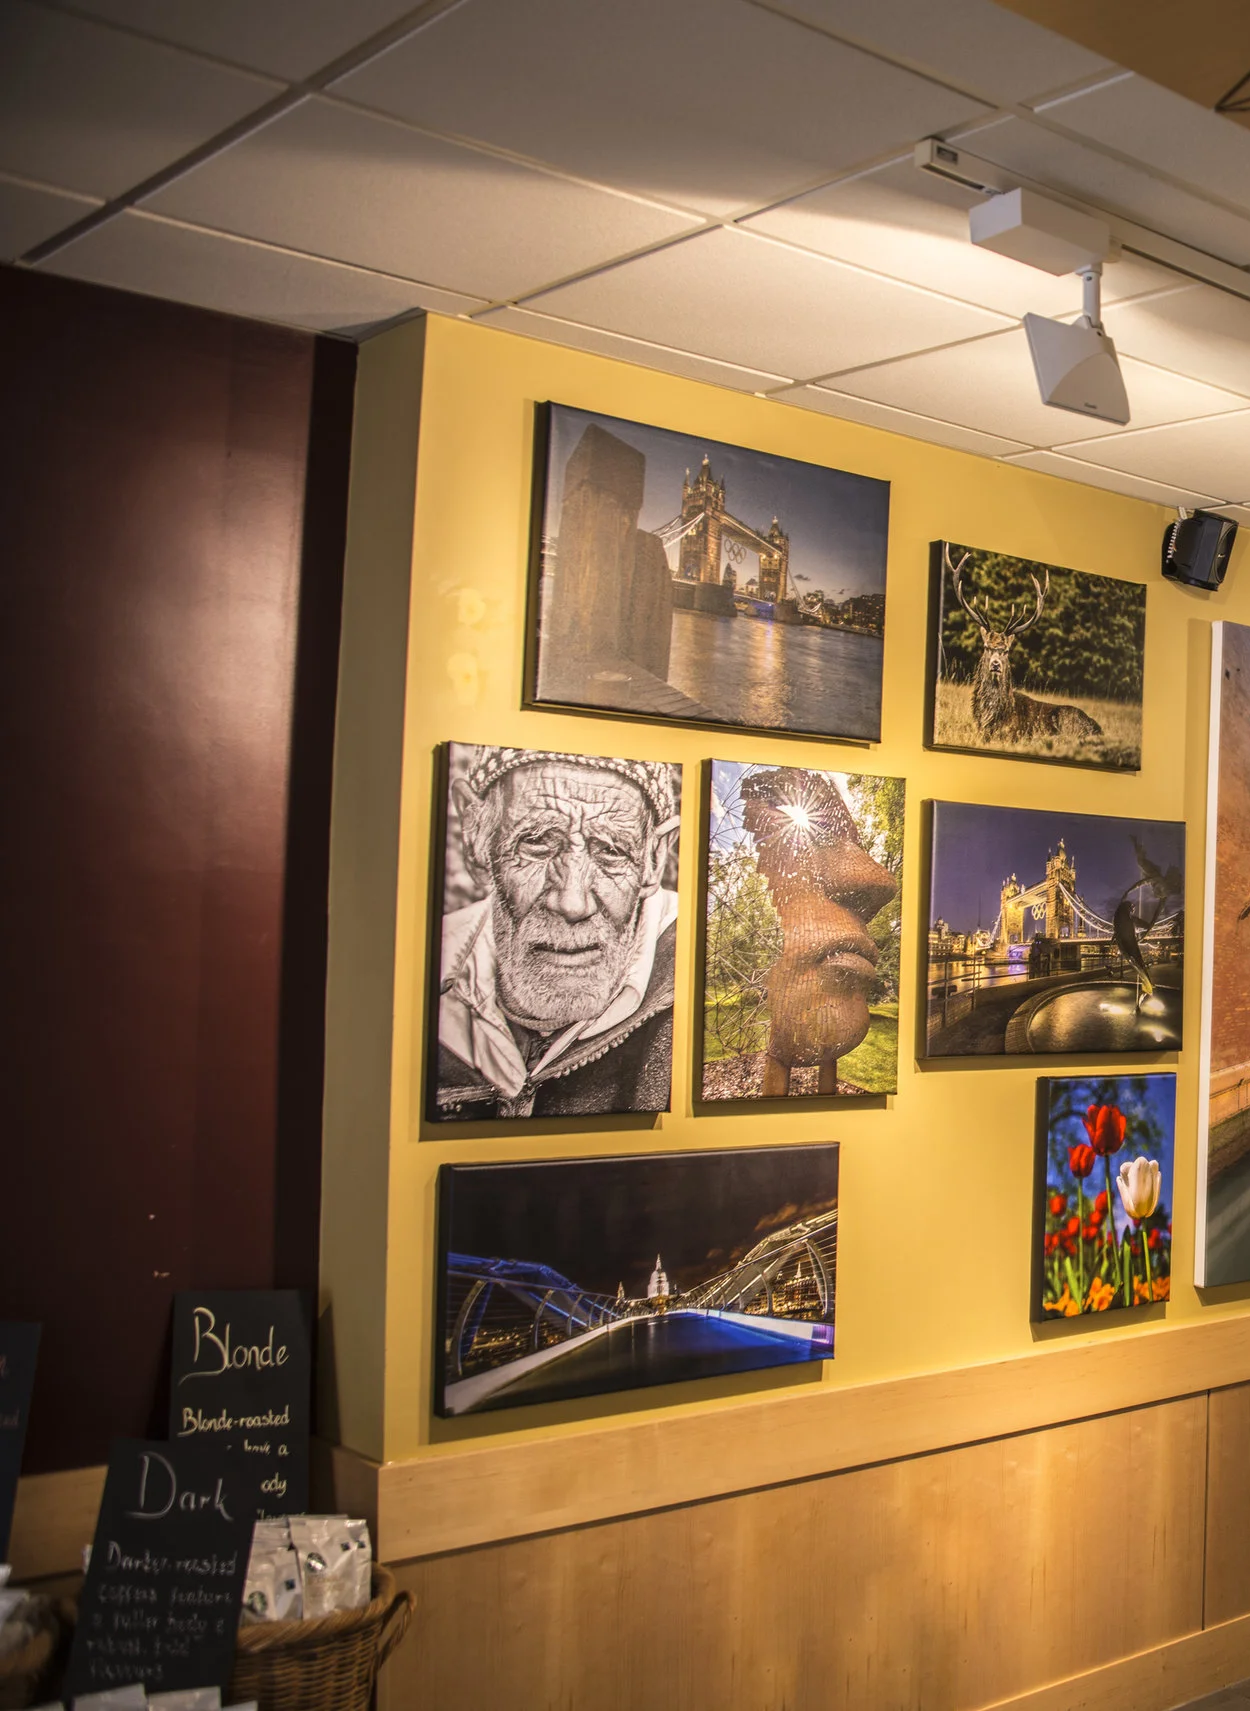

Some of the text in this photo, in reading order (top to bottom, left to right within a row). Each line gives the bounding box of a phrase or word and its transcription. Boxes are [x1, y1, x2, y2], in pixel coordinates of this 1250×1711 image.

[179, 1307, 290, 1386] Blonde
[178, 1404, 290, 1437] Blonde-roasted
[126, 1450, 234, 1523] Dark
[261, 1472, 287, 1498] ody
